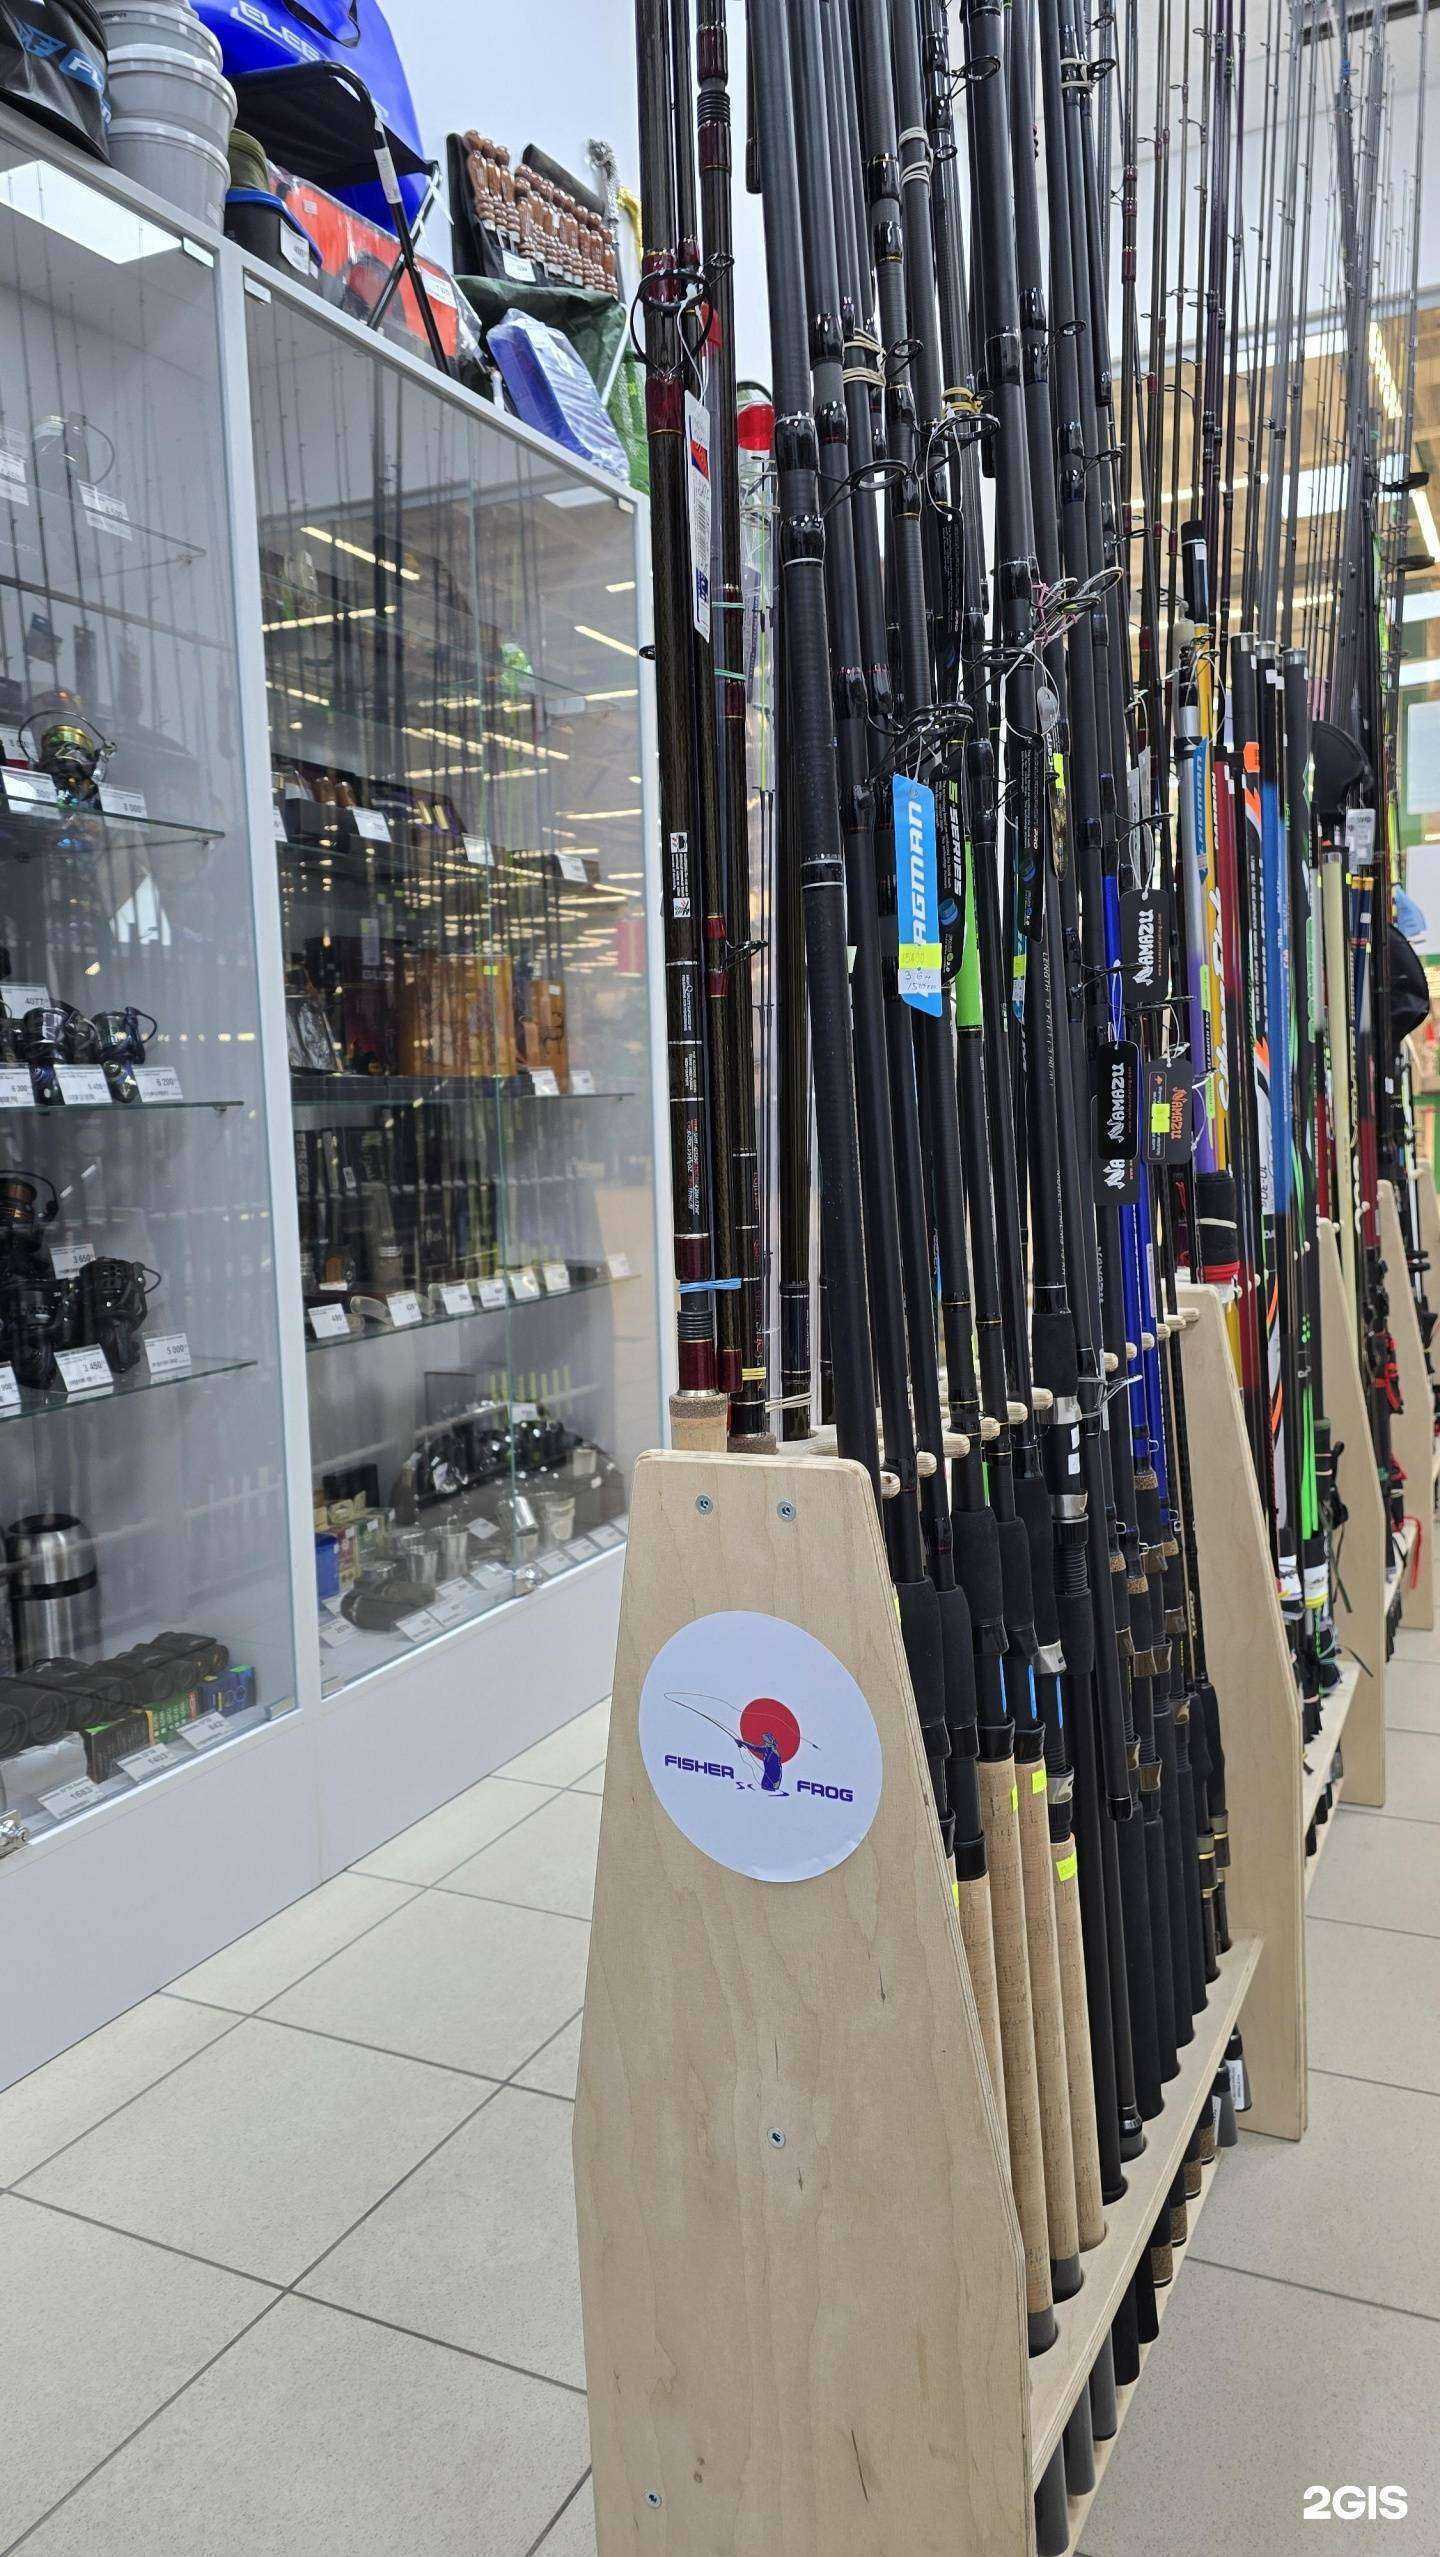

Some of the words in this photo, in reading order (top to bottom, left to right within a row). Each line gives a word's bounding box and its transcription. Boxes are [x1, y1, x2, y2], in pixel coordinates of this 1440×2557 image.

[908, 800, 932, 980] AGMAN
[1132, 909, 1154, 986] NAMAZU
[1107, 1062, 1125, 1143] NAMAZU
[1170, 1086, 1188, 1140] NAMAZU
[664, 1754, 735, 1780] FISHER
[796, 1779, 854, 1803] FROG
